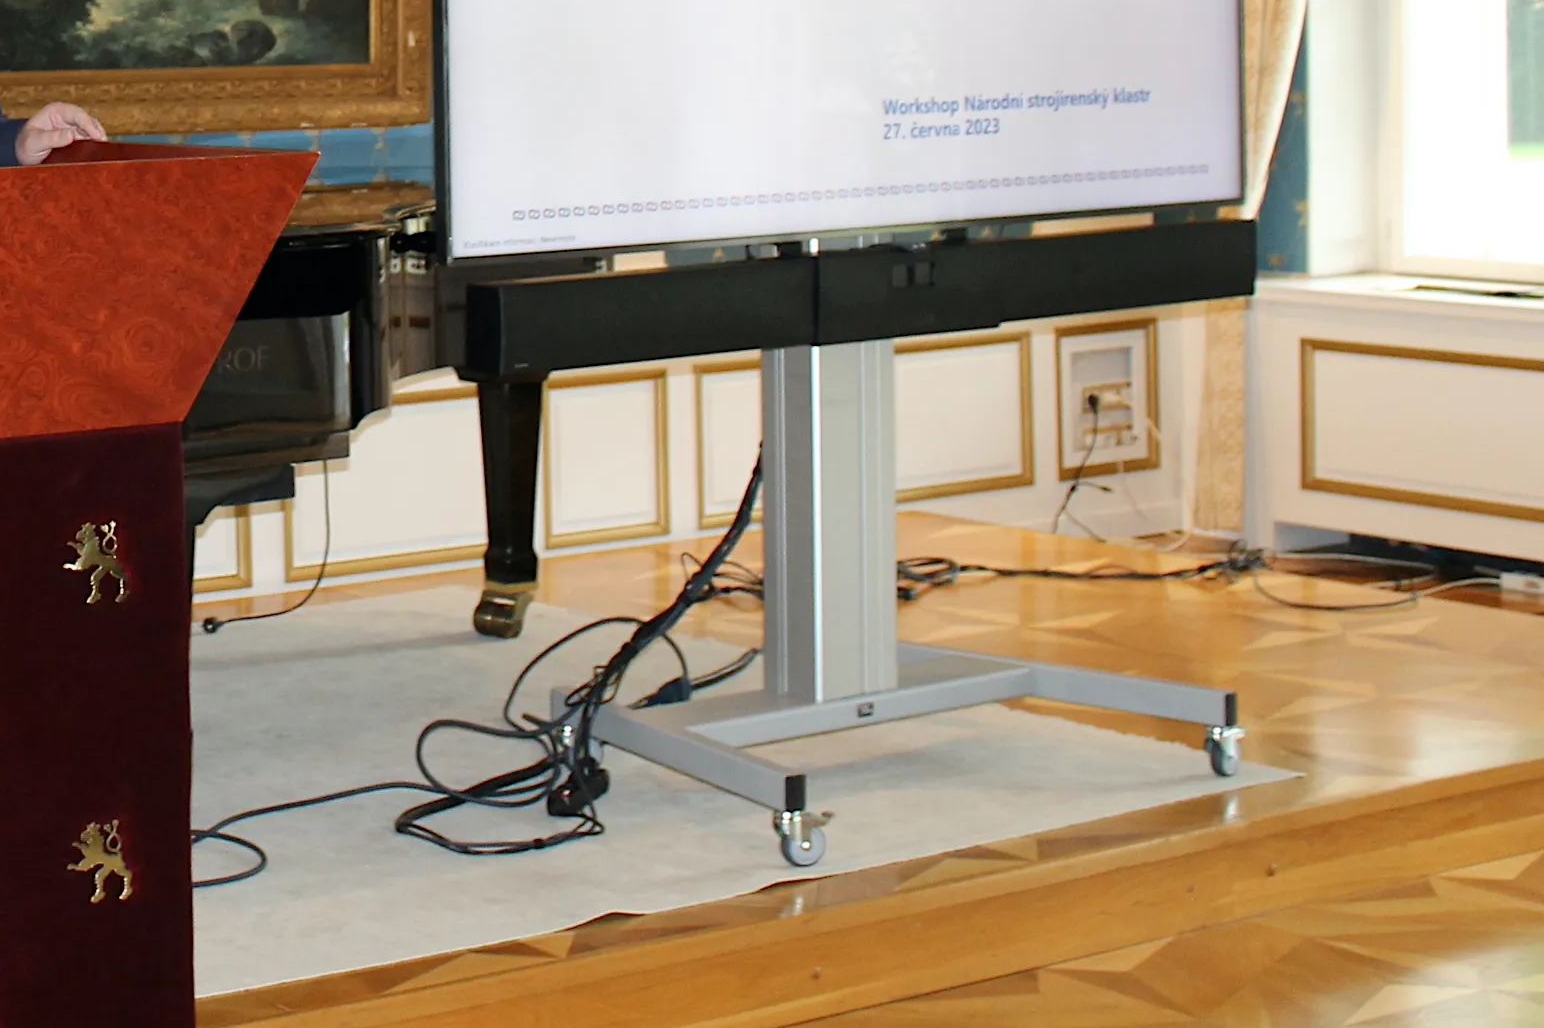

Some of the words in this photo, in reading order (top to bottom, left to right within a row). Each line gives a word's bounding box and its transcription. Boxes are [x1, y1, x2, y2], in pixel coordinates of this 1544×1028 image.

[883, 98, 960, 117] Workshop
[964, 93, 1024, 111] Národní
[1113, 87, 1152, 104] klastr
[883, 123, 906, 140] 27.
[910, 122, 961, 139] června
[965, 118, 1000, 136] 2023
